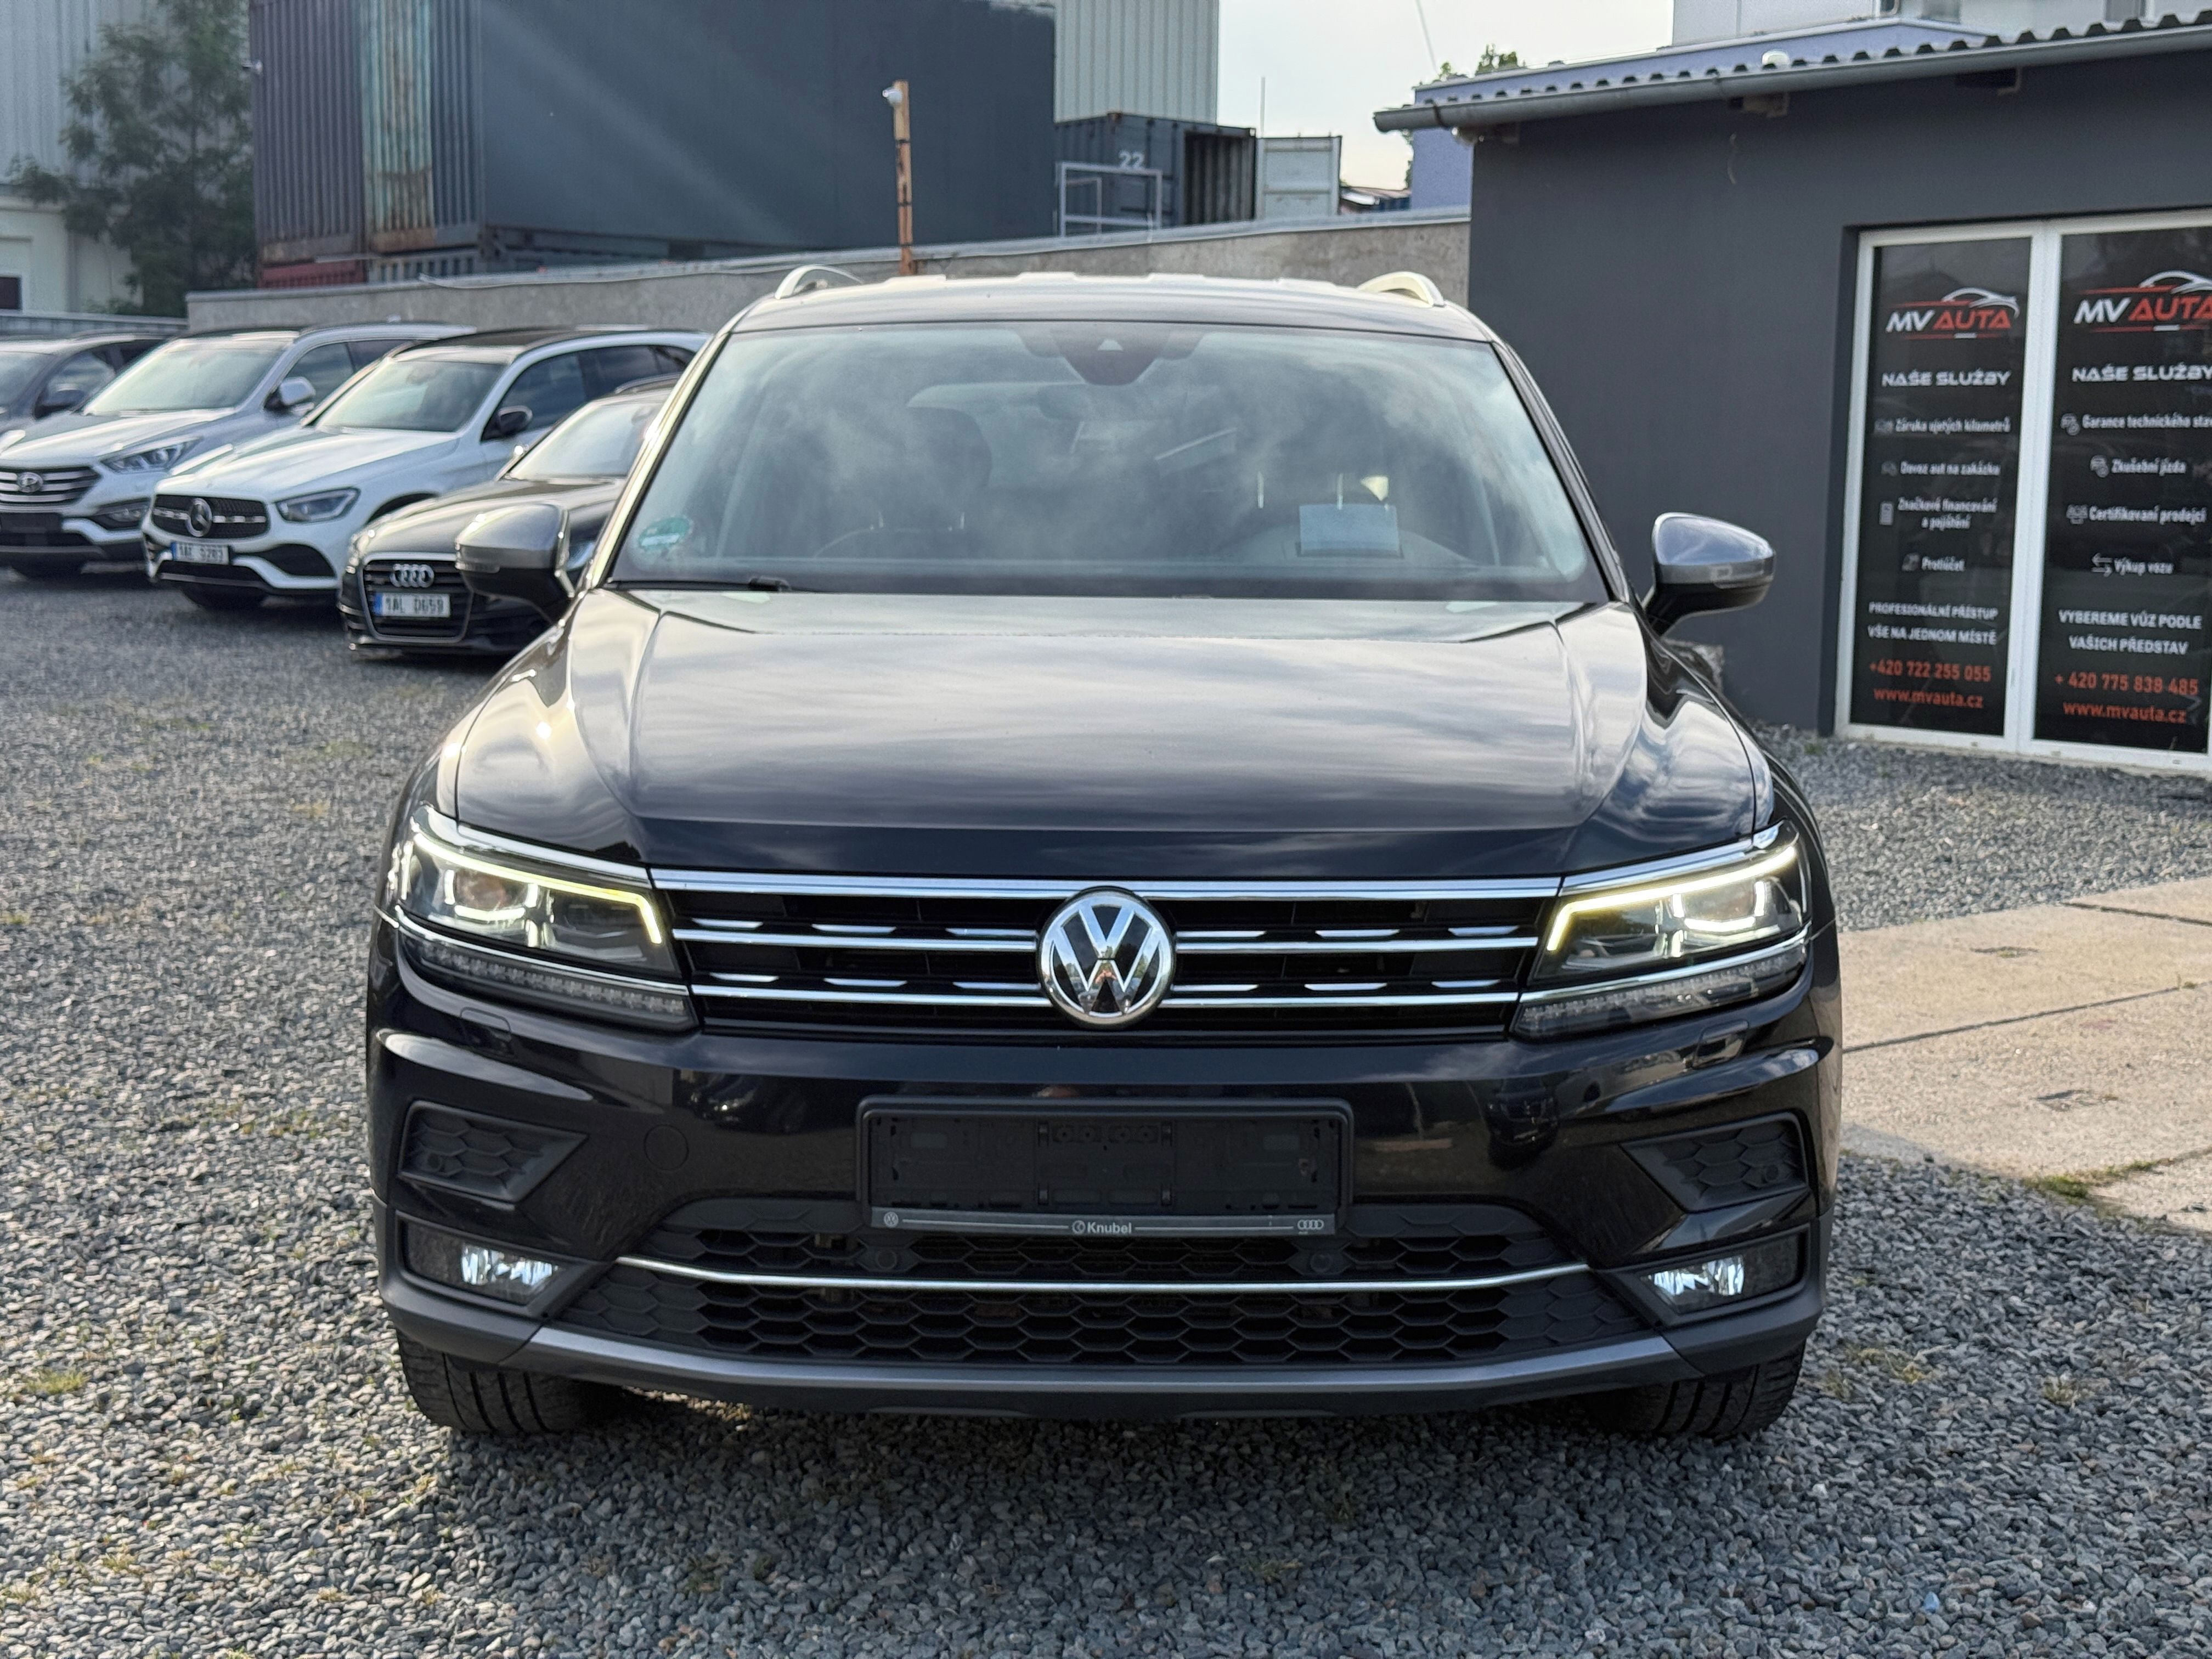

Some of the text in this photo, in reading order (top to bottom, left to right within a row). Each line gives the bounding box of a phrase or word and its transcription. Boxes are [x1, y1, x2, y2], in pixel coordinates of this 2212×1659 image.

[2074, 295, 2212, 324] MV AUTA
[1886, 309, 2011, 332] MV AUTA
[1882, 368, 2011, 386] NAŠE SLUŽBY
[2072, 362, 2212, 381] NAŠE SLUŽBY
[2114, 557, 2174, 576] Výkup vozu
[2058, 610, 2202, 630] VYBEREME VŮZ PODLE
[1891, 626, 1906, 640] NA
[1909, 627, 1957, 642] JEDNOM
[2069, 634, 2189, 655] VAŠICH PŘEDSTAV
[1870, 658, 1991, 682] +420 722 255 055
[2069, 672, 2097, 689] 420
[2100, 673, 2129, 691] 775
[2168, 678, 2199, 696] 485
[1874, 687, 1984, 708] www.mvauta.cz
[2063, 702, 2187, 724] www.mvauta.cz
[1087, 1221, 1132, 1233] Knubel
